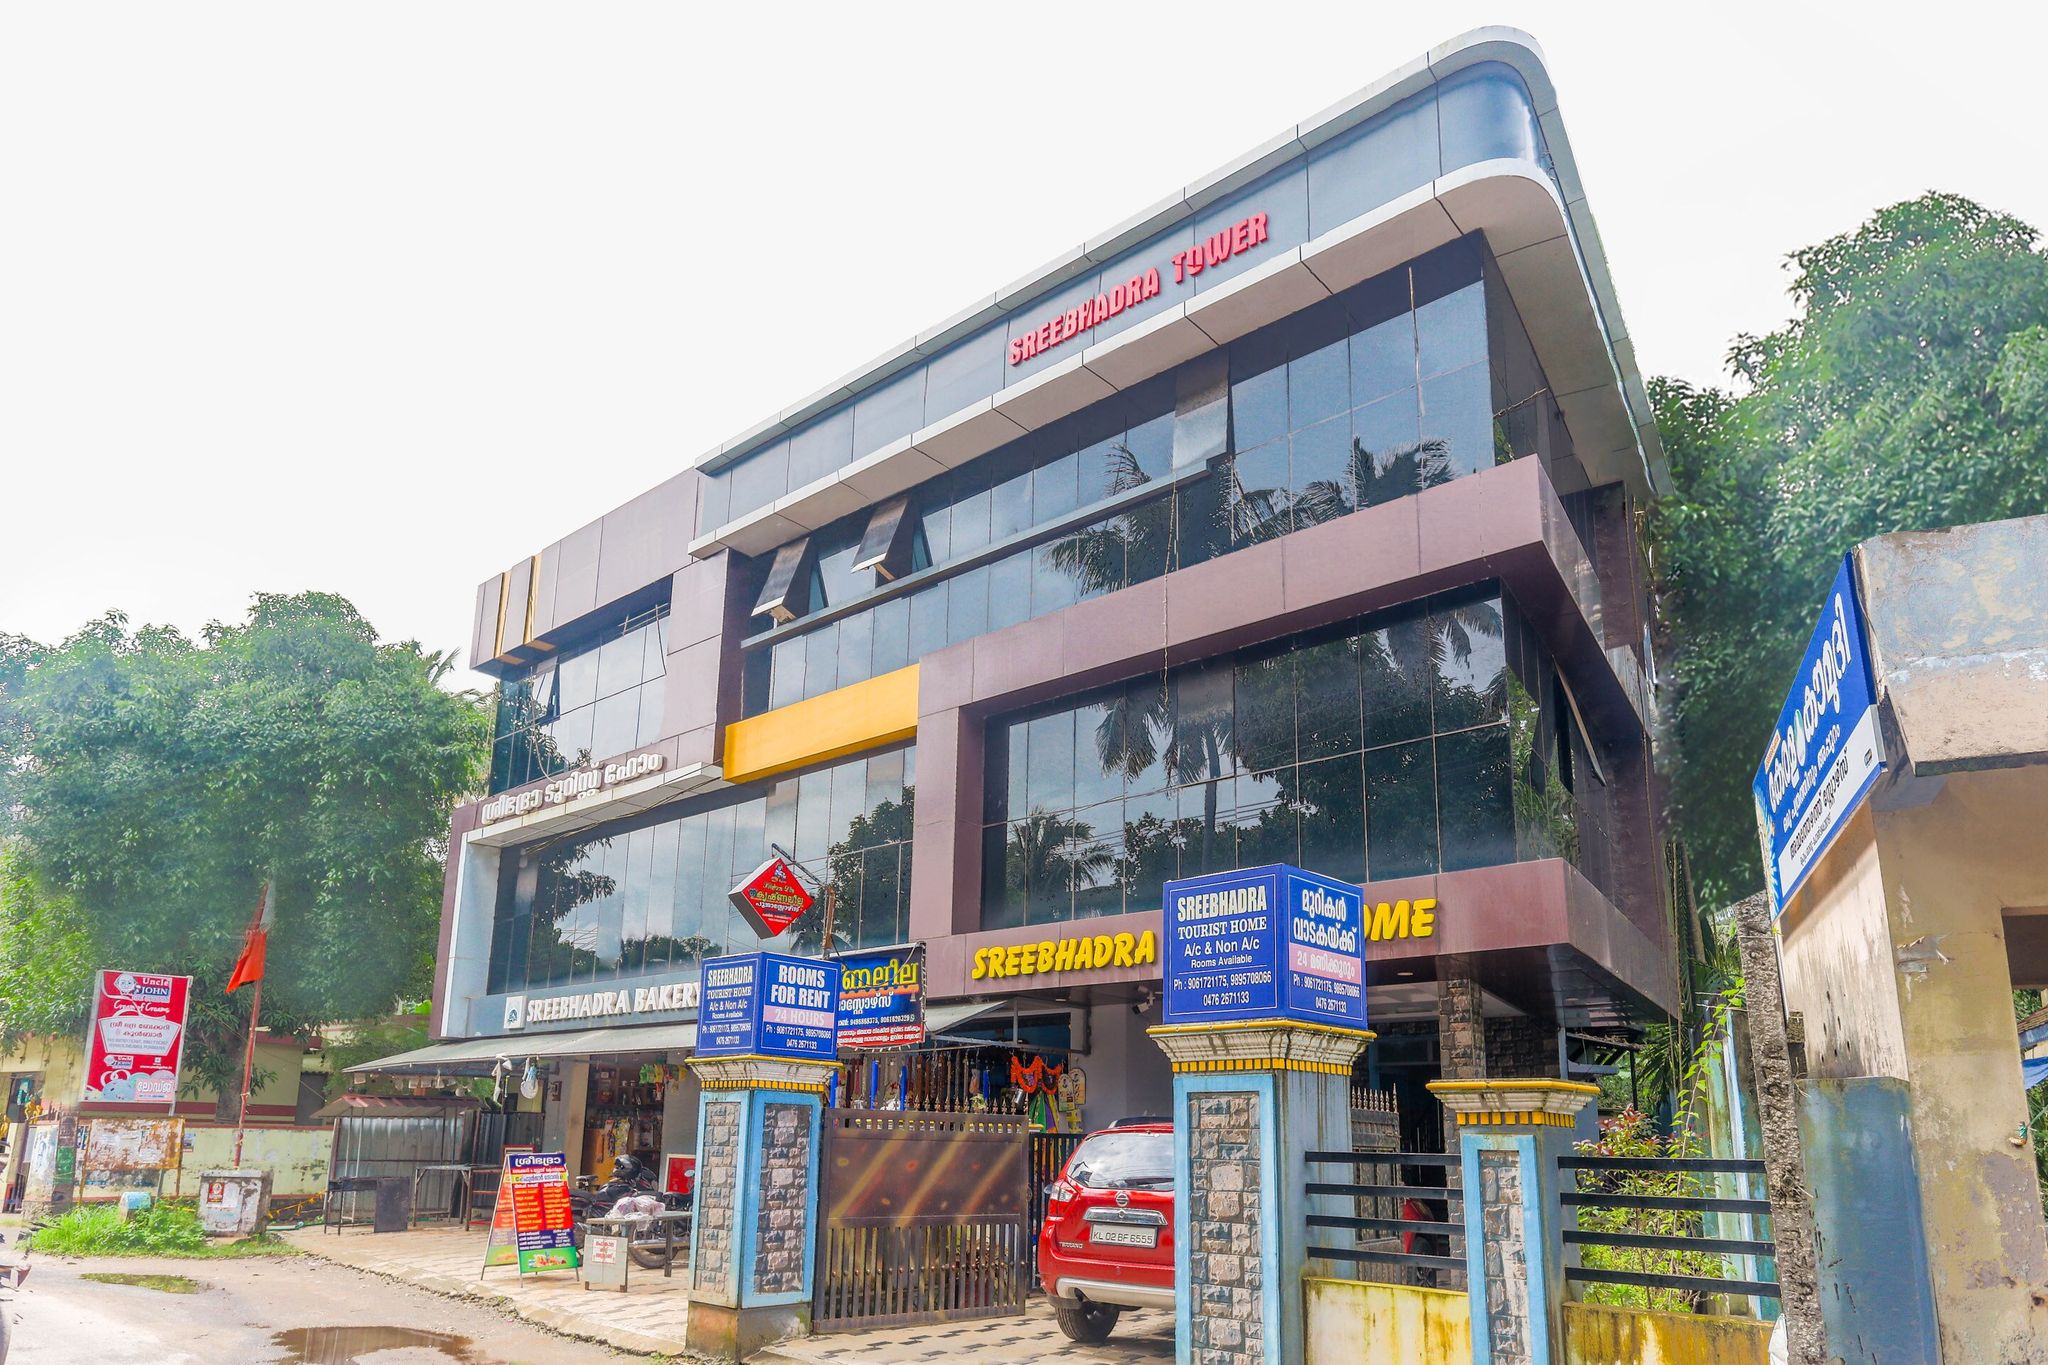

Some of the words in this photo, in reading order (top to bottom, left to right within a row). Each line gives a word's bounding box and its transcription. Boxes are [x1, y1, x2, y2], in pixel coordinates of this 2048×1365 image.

[1008, 267, 1160, 366] SREEBHADRA
[1171, 211, 1269, 284] TOWER
[1177, 885, 1267, 922] SREEBHADRA
[1302, 887, 1346, 922] മുറികൾ
[1177, 921, 1228, 940] TOURIST
[1230, 916, 1267, 934] HOME
[971, 930, 1155, 980] SREEBHADRA
[1364, 898, 1437, 942] ME
[1184, 943, 1202, 957] A/c
[1204, 941, 1212, 955] &
[1215, 940, 1238, 954] Non
[1241, 936, 1260, 951] A/c
[1191, 959, 1216, 969] Rooms
[1218, 954, 1253, 966] Available
[1297, 950, 1308, 967] 24
[142, 977, 168, 987] Uncle
[707, 966, 753, 988] SREEBHADRA
[778, 964, 826, 989] ROOMS
[1230, 971, 1272, 986] 9895708066
[141, 986, 168, 995] JOHN
[706, 989, 733, 1000] TOURIST
[733, 986, 752, 998] HOME
[770, 984, 796, 1005] FOR
[798, 987, 830, 1009] RENT
[1203, 994, 1220, 1006] 0476
[1220, 991, 1250, 1004] 2671133
[526, 989, 632, 1023] SREEBHADRA
[709, 1002, 719, 1012] A/c
[719, 1001, 725, 1011] &
[725, 1000, 736, 1010] Non
[737, 999, 748, 1009] A/c
[775, 1008, 787, 1021] 24
[791, 1009, 825, 1026] HOURS
[1093, 1232, 1103, 1241] KL
[1105, 1232, 1116, 1242] 02
[1117, 1233, 1129, 1243] BF
[1129, 1233, 1153, 1244] 6555
